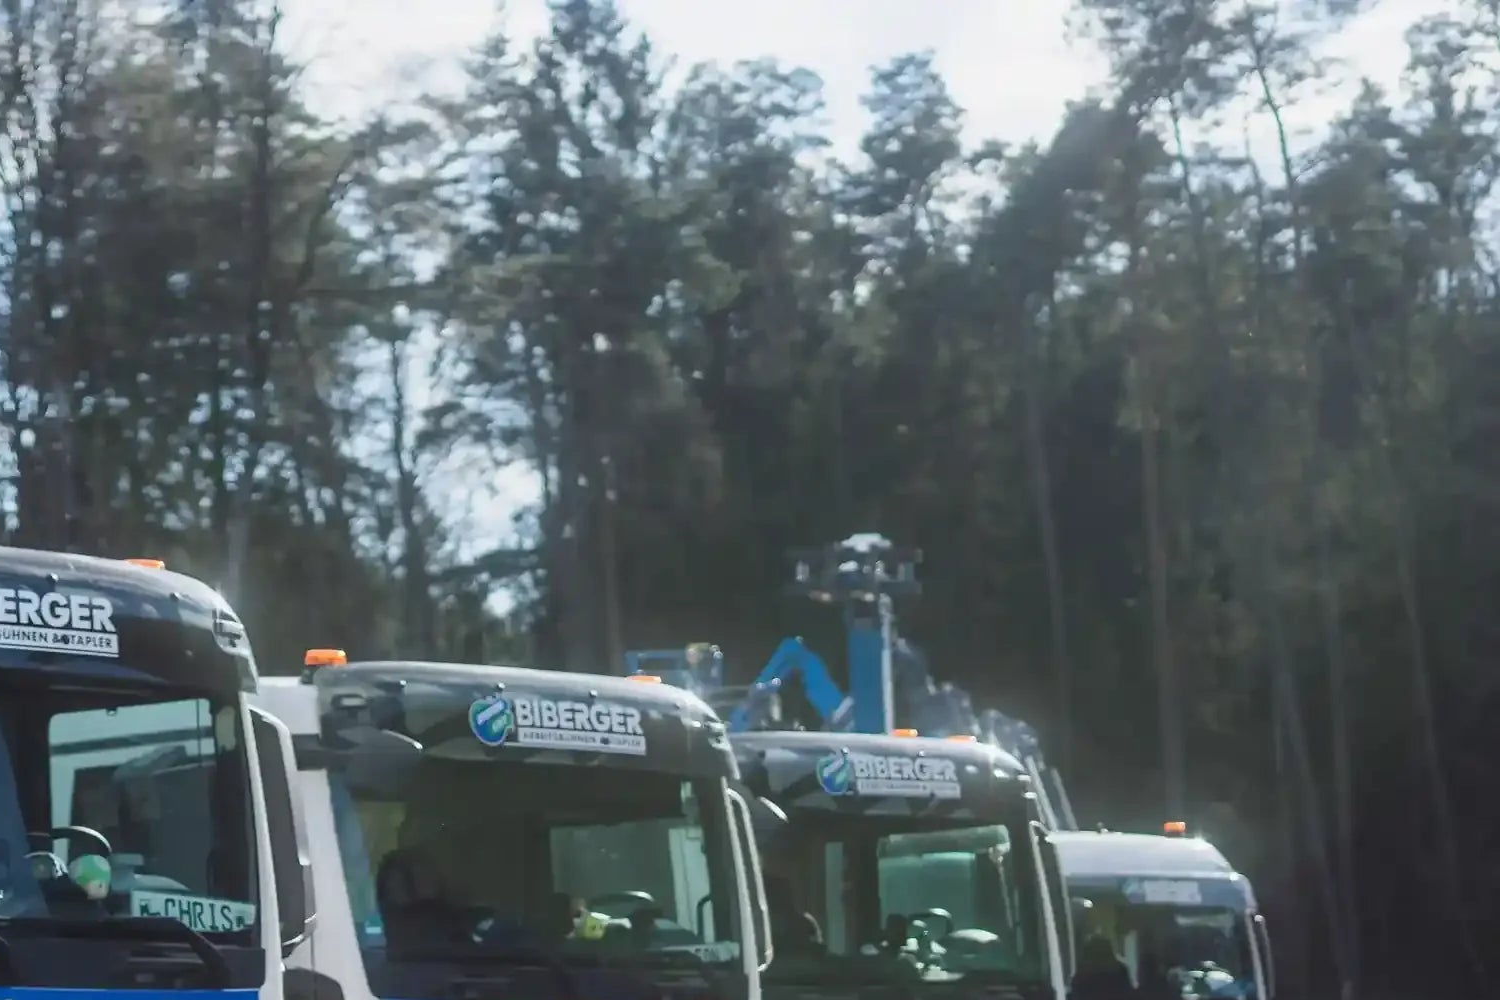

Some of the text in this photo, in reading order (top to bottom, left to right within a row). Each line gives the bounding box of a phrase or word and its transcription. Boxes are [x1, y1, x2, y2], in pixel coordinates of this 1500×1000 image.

[61, 634, 112, 649] TAPLER
[514, 699, 644, 735] BIBERGER
[853, 756, 958, 782] BIBERGER
[163, 898, 233, 931] CHRIS
